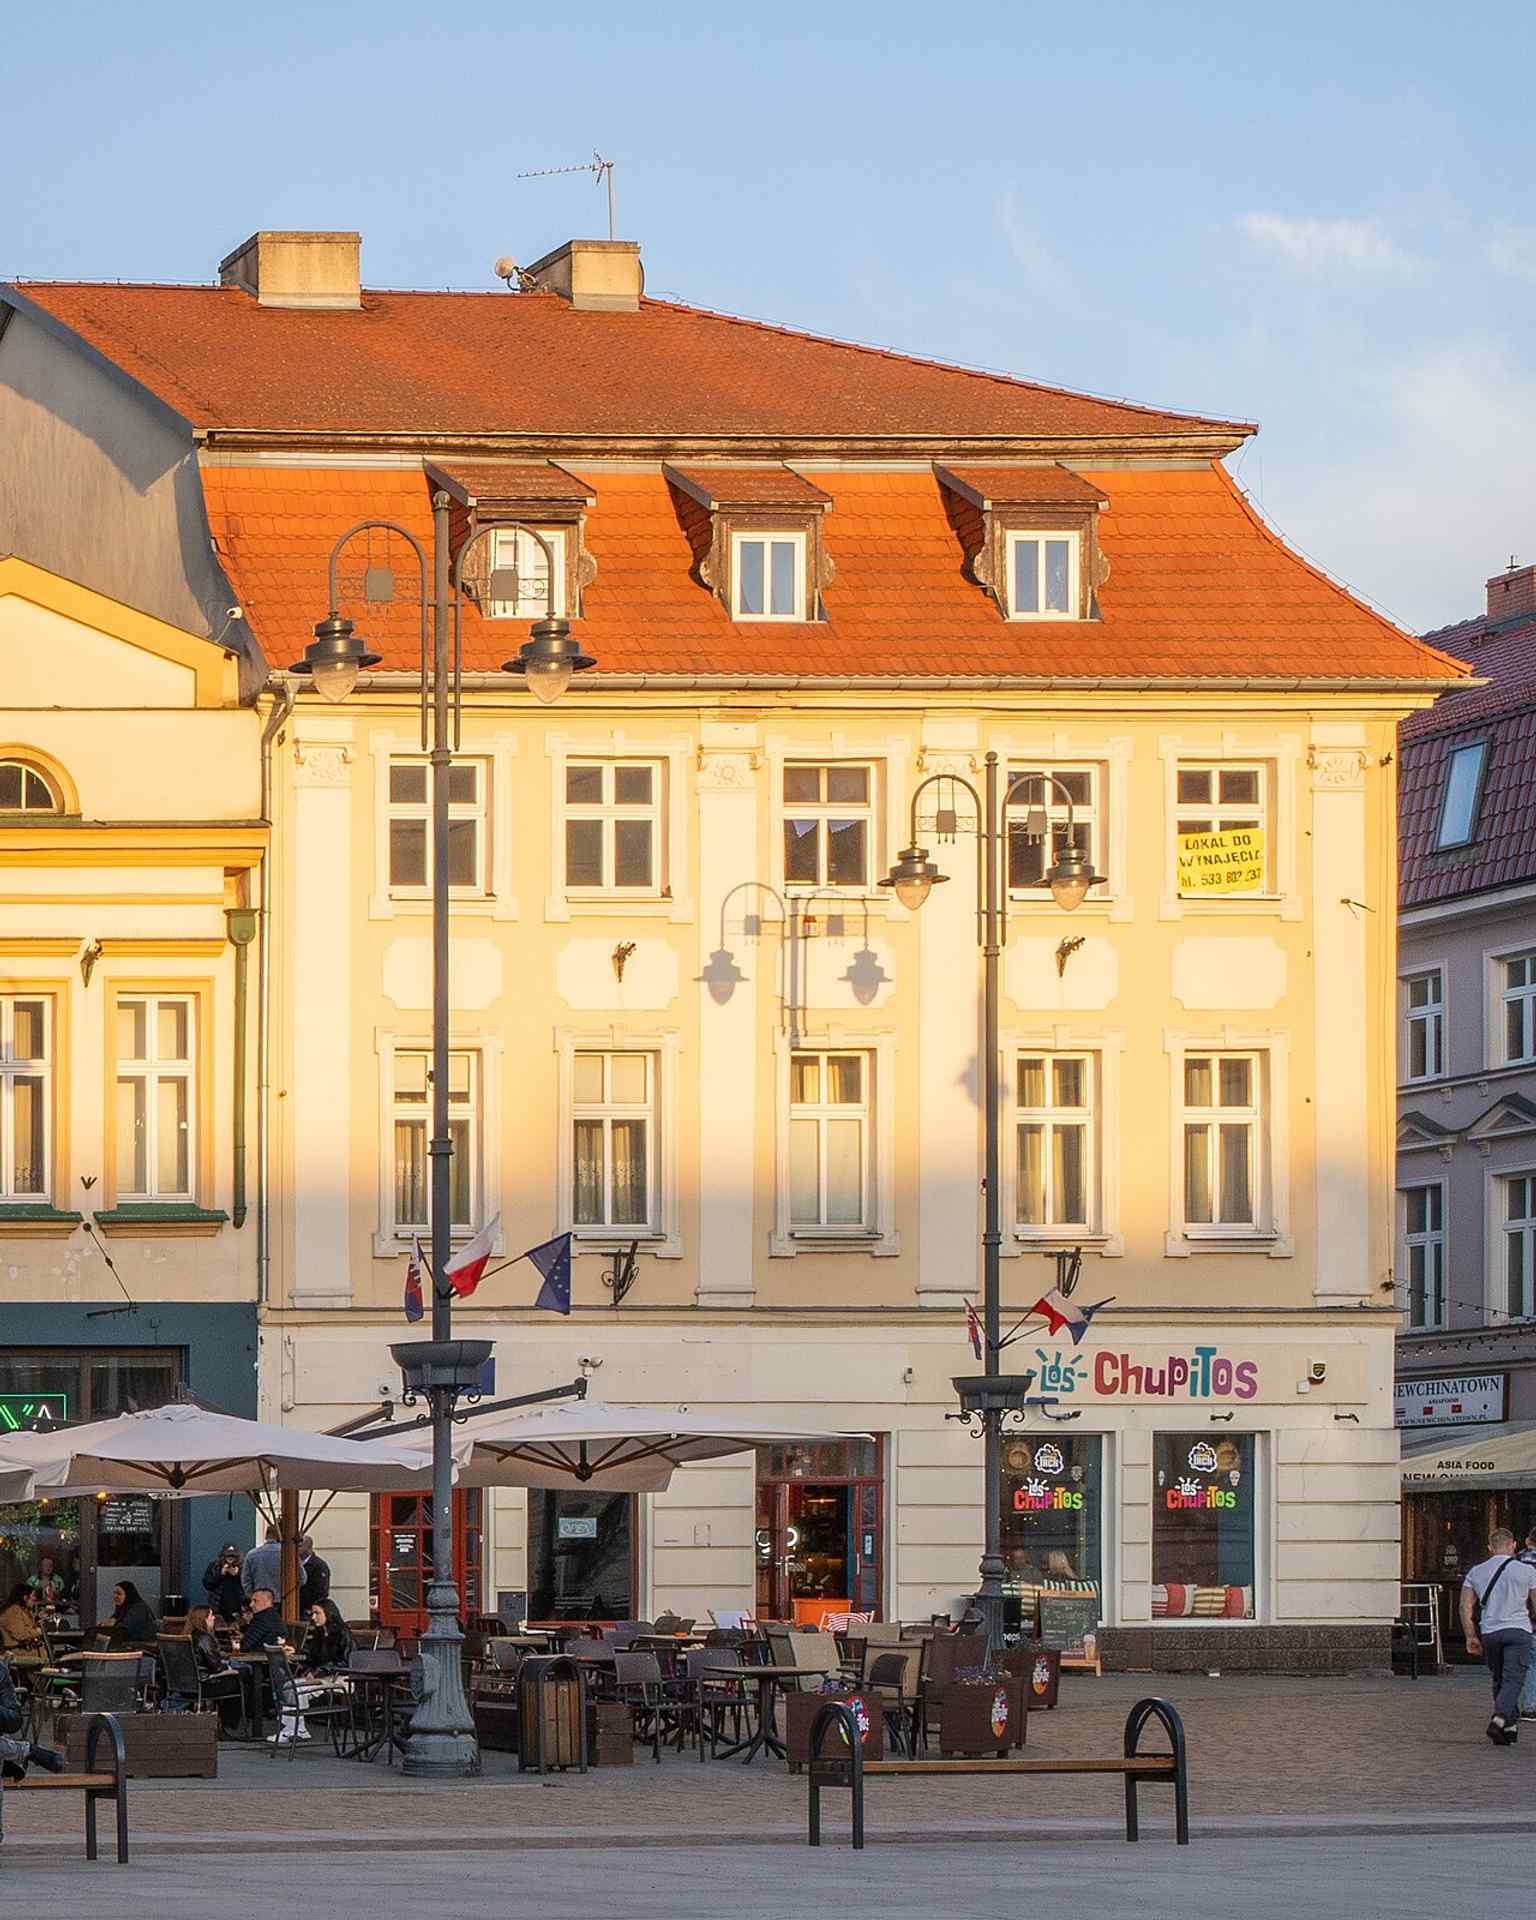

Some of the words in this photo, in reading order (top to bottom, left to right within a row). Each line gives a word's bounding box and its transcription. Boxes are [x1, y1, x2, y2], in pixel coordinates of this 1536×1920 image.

[1185, 837, 1228, 850] LOKAL
[1232, 834, 1251, 846] DO
[1437, 1461, 1462, 1470] ASIA
[1465, 1461, 1495, 1470] FOOD
